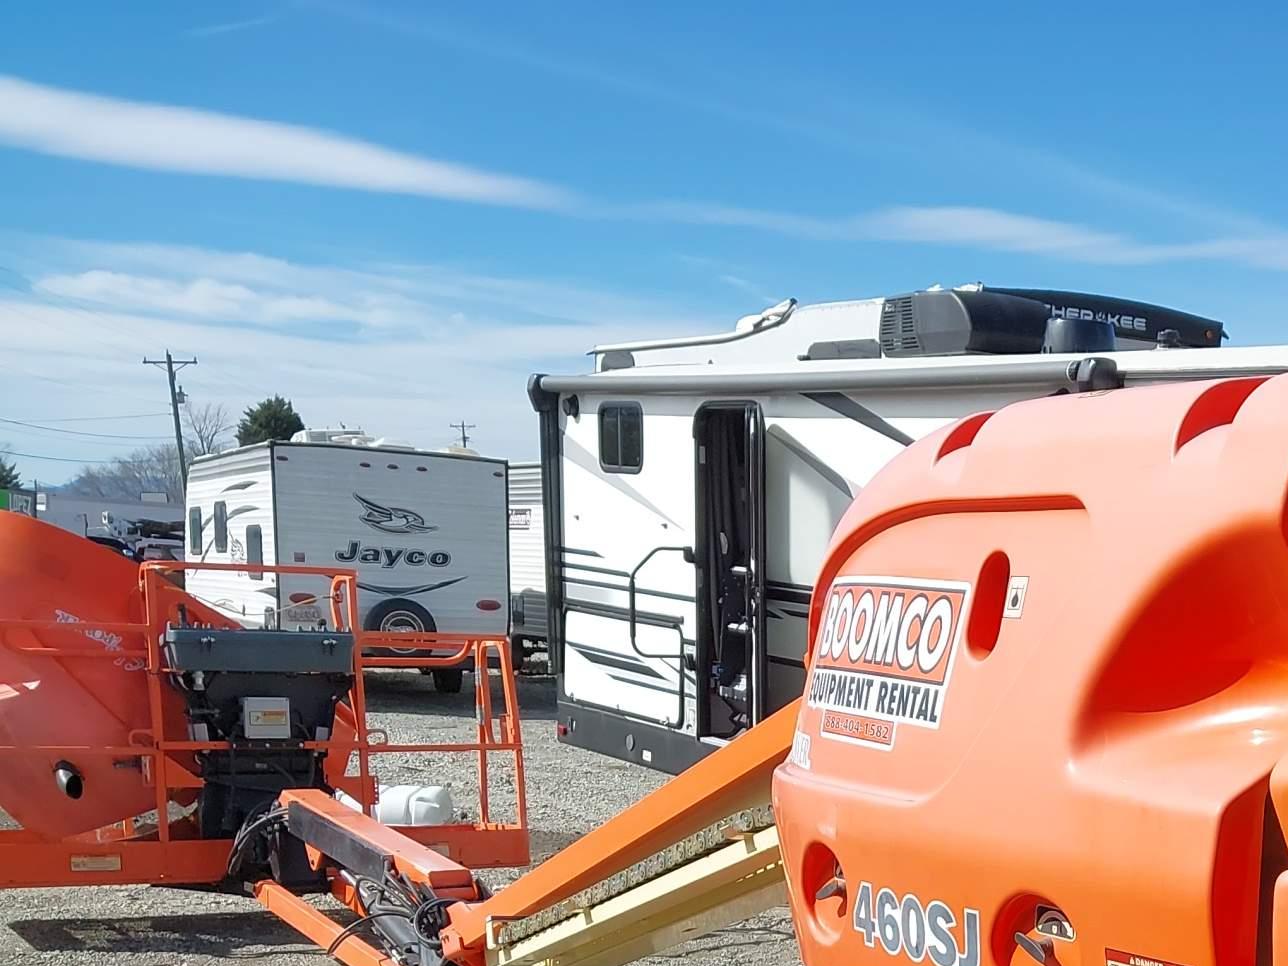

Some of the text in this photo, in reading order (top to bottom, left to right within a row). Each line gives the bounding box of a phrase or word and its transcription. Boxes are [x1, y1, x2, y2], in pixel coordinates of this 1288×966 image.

[335, 540, 451, 568] Jayco
[820, 588, 953, 673] BOOMCO
[876, 681, 938, 723] RENTAL
[825, 715, 889, 739] 888-404-1582
